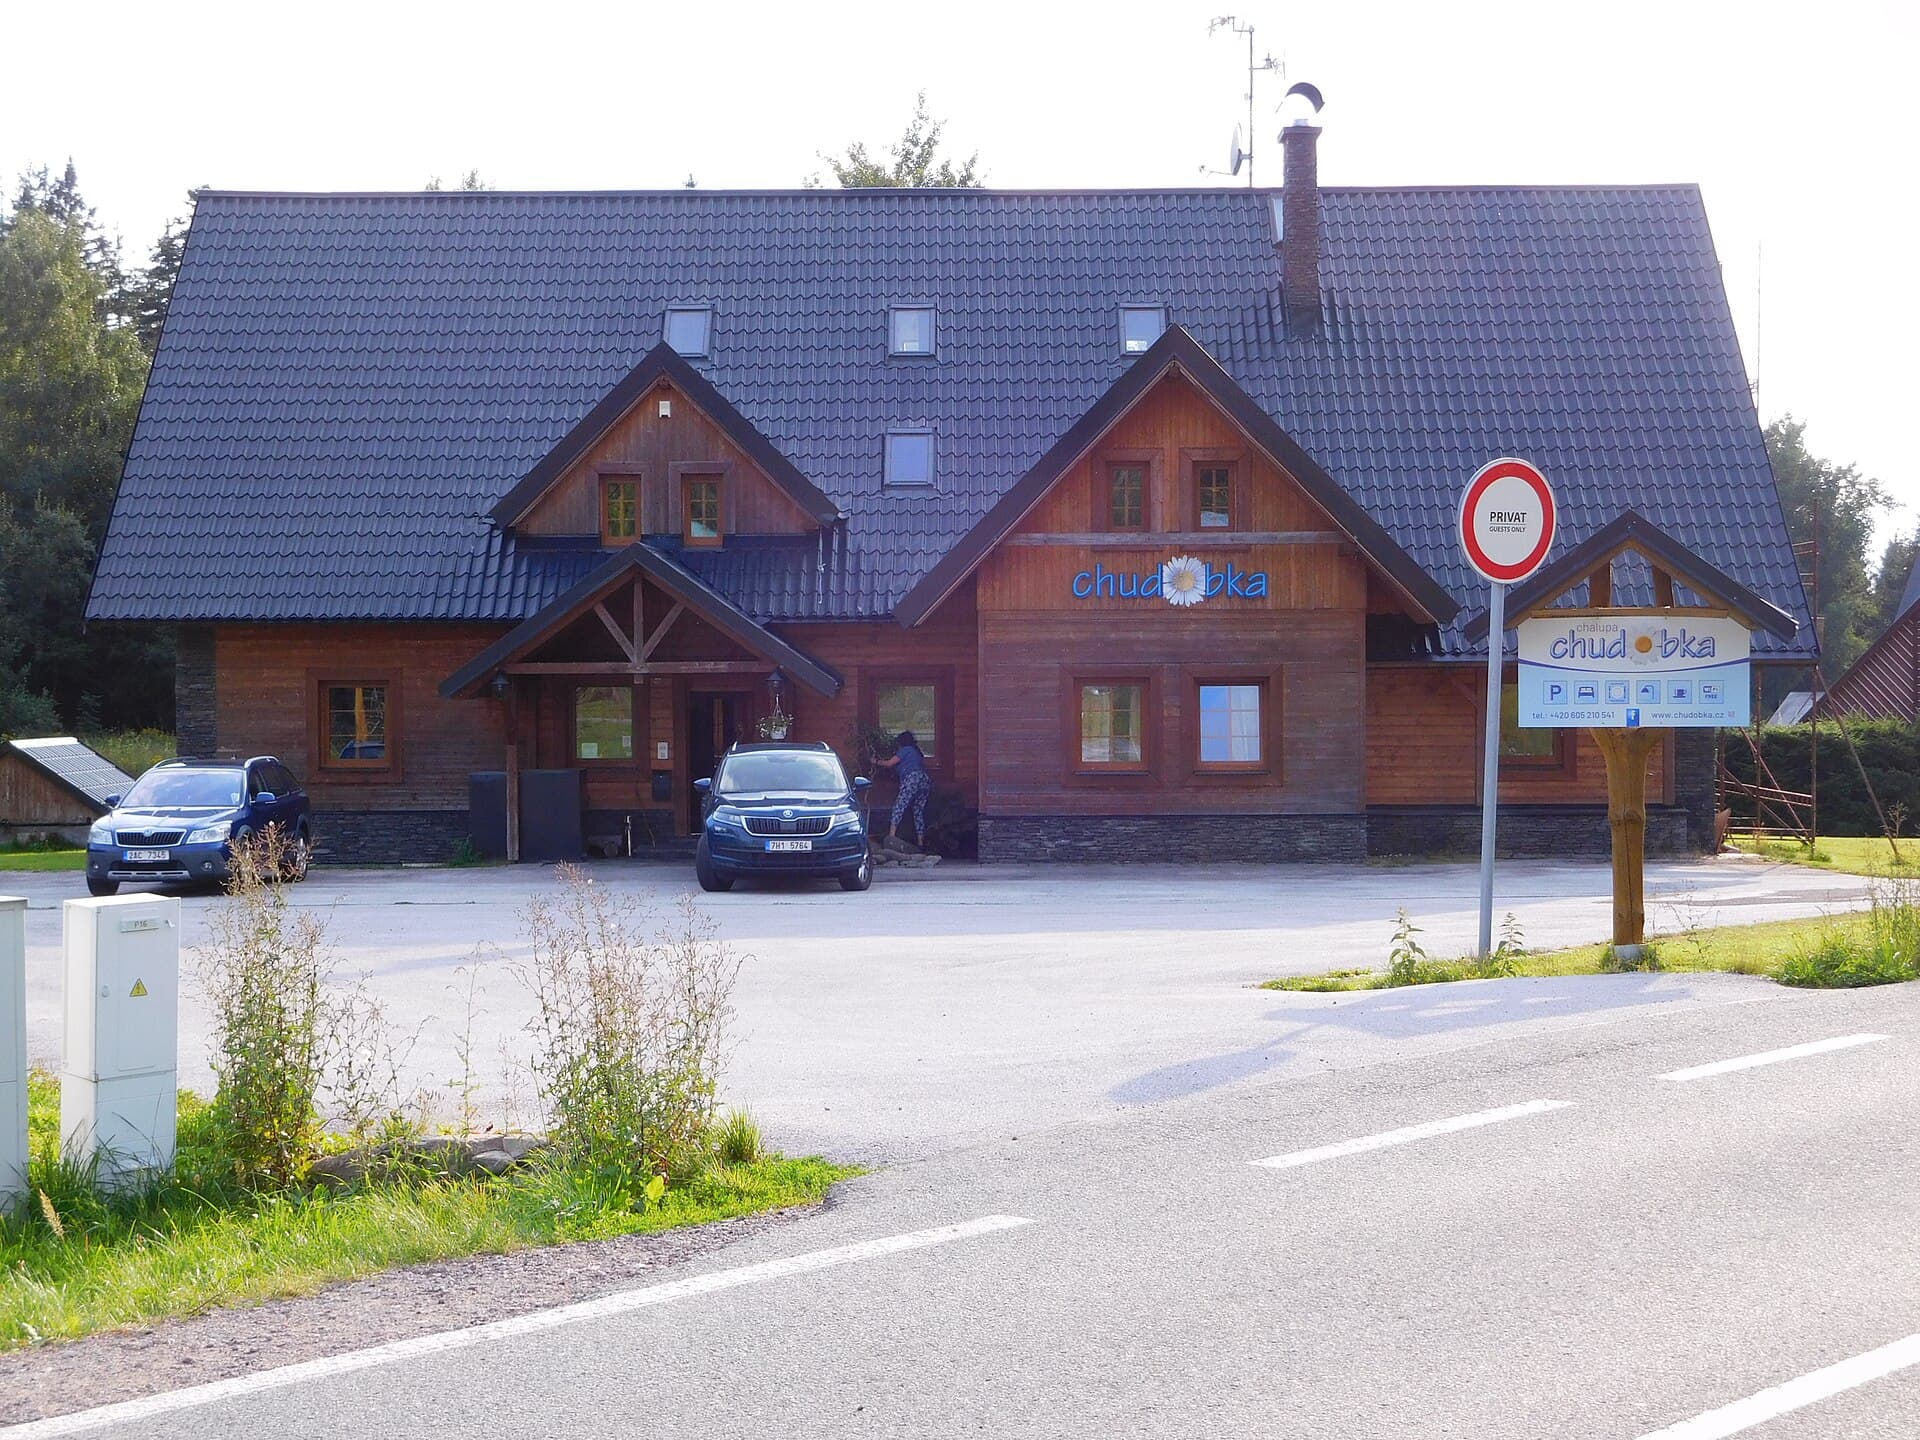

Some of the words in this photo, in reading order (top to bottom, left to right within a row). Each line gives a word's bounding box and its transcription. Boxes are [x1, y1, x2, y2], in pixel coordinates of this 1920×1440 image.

[1489, 511, 1527, 523] PRIVAT
[1576, 623, 1619, 633] chalupa
[1550, 711, 1570, 719] +420
[1586, 711, 1600, 719] 210
[1601, 711, 1615, 719] 541
[1651, 710, 1726, 719] www.chudobka.cz
